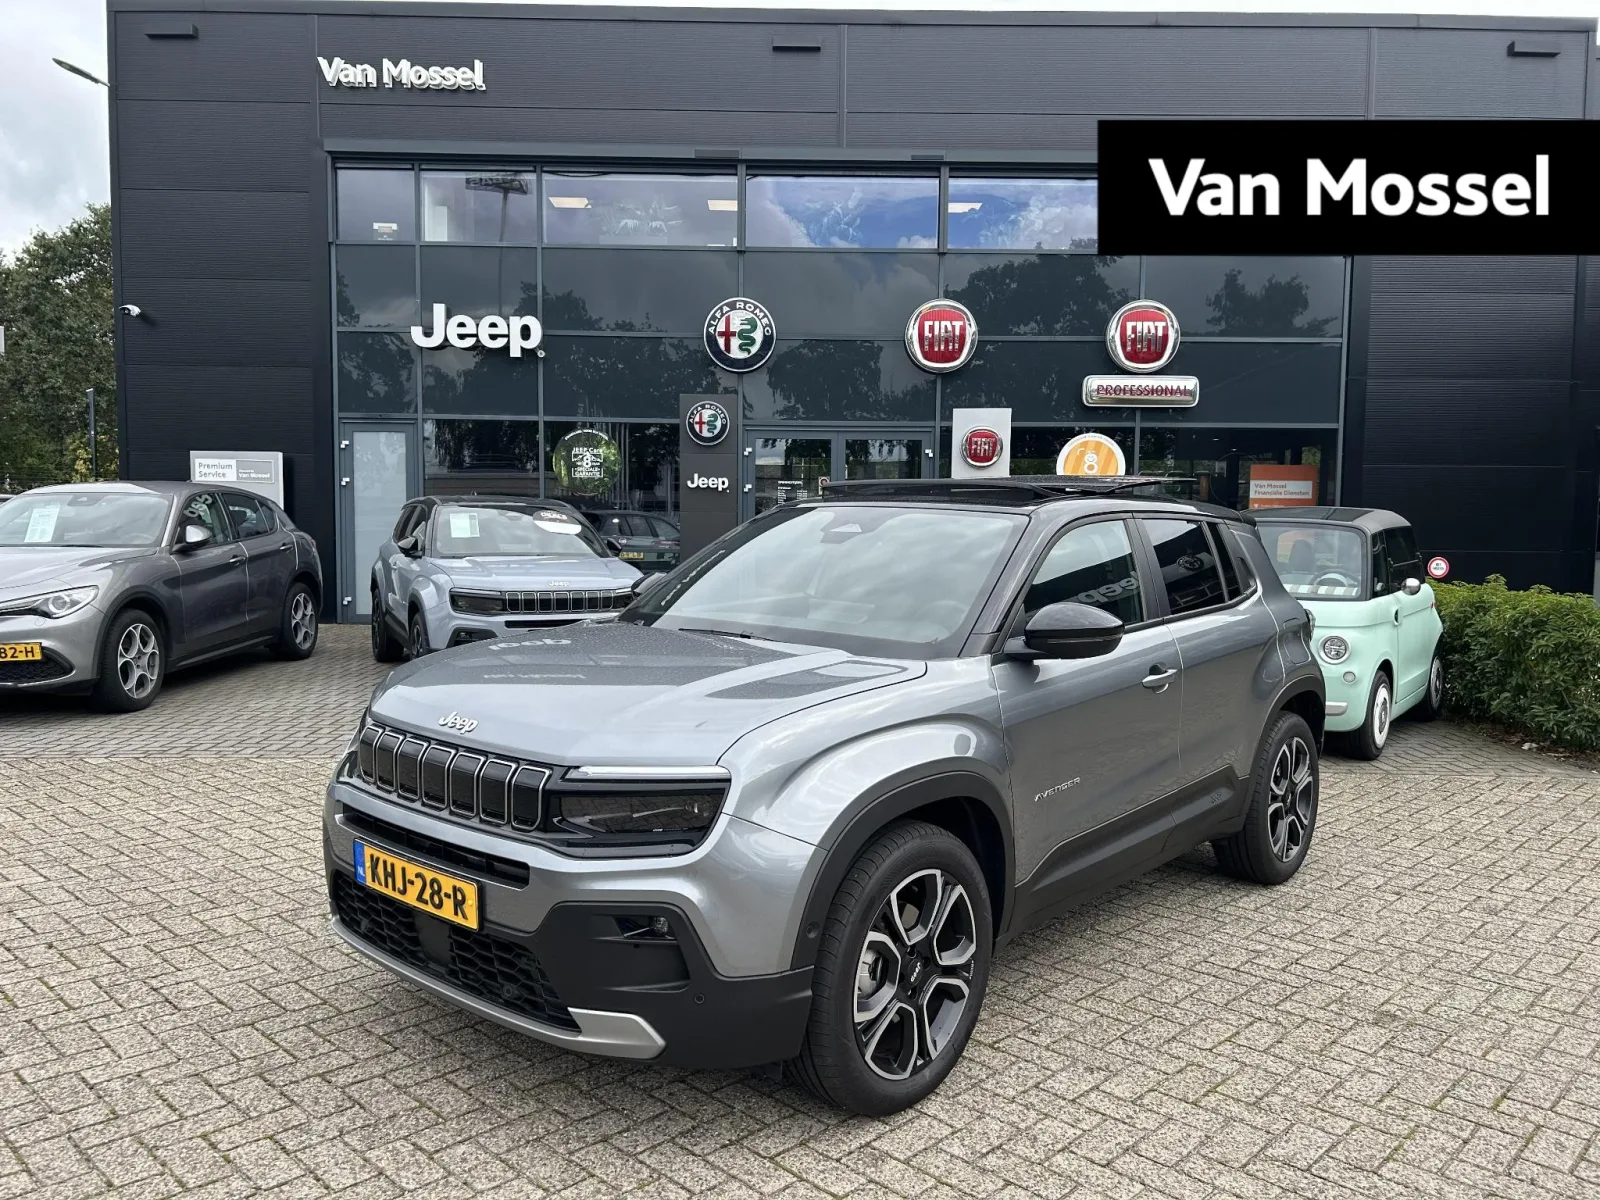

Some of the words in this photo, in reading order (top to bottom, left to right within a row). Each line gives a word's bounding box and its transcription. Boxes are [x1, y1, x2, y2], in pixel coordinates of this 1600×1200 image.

[317, 57, 377, 87] Van
[382, 58, 486, 90] Mossel
[410, 303, 543, 357] Jeep
[708, 305, 730, 335] ALFA
[736, 301, 772, 336] ROMEO
[923, 320, 963, 351] FIAT
[1125, 321, 1166, 351] FIAT
[1096, 384, 1190, 397] PROFESSIONAL
[689, 406, 702, 424] ALFA
[705, 404, 727, 424] ROMEO
[971, 437, 995, 457] FIAT
[198, 462, 233, 470] Premium
[198, 470, 227, 478] Service
[686, 473, 729, 491] Jeep
[438, 711, 479, 734] Jeep
[1034, 776, 1081, 802] AVENGER
[357, 866, 365, 877] NL
[370, 853, 469, 921] KHJ-28-R
